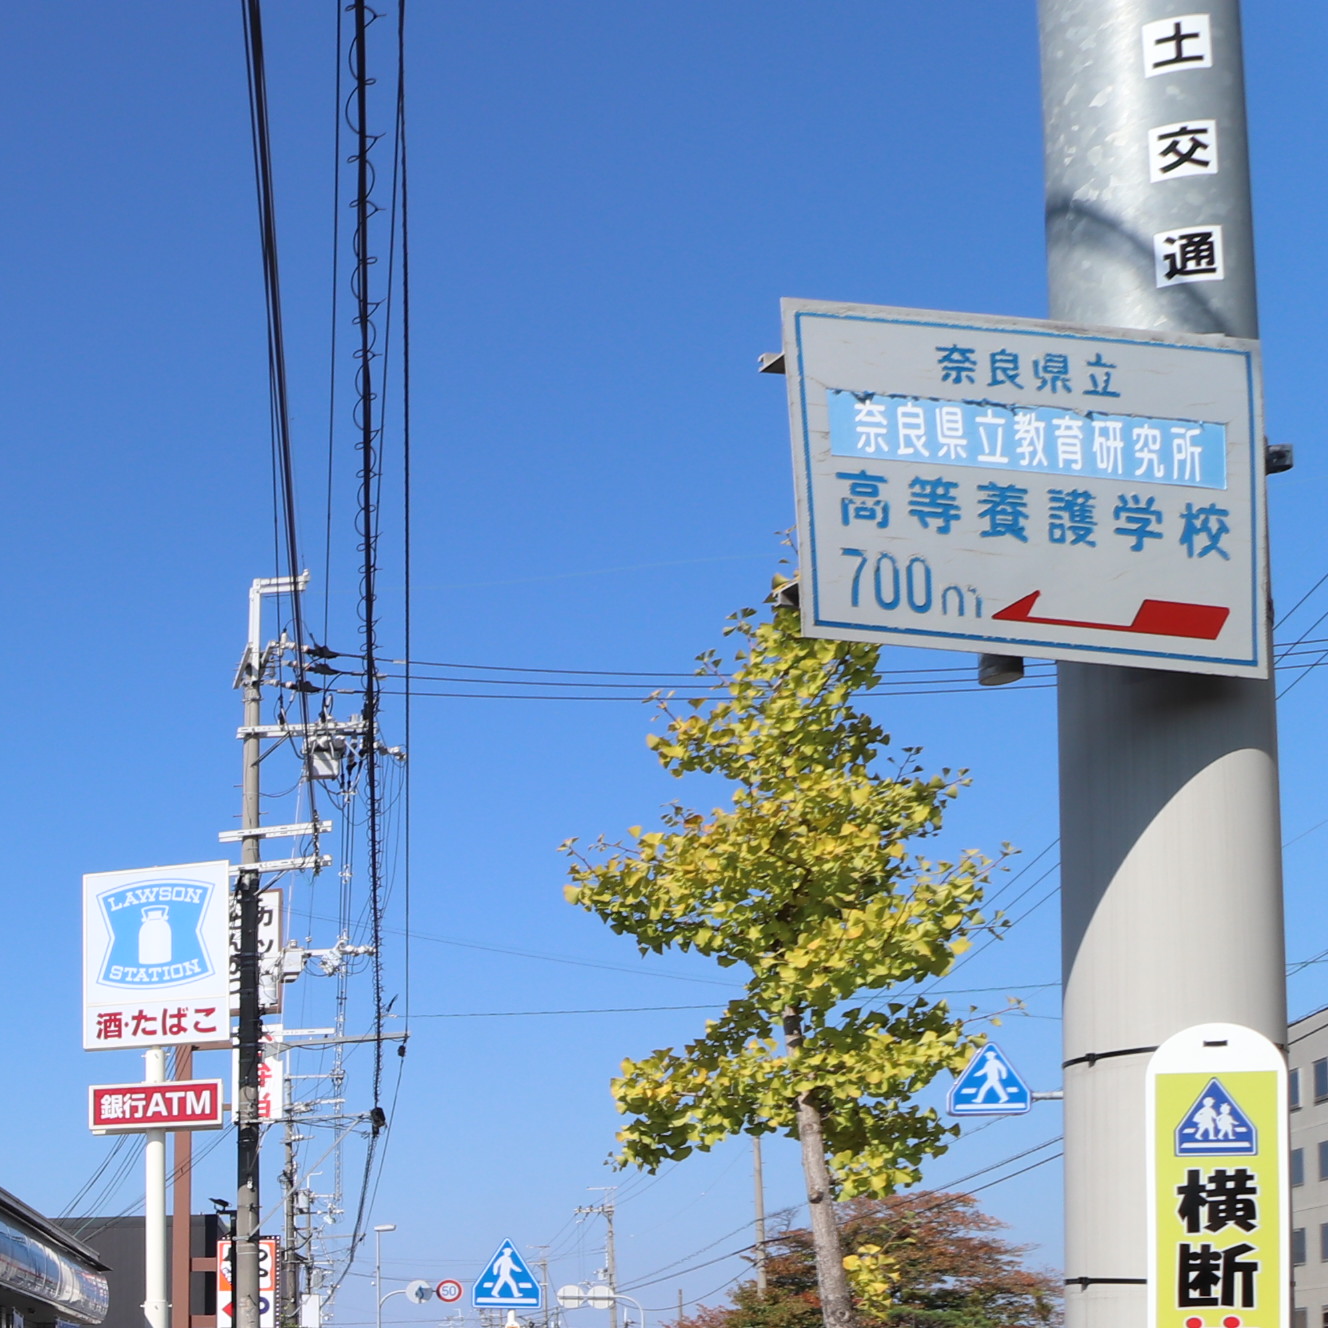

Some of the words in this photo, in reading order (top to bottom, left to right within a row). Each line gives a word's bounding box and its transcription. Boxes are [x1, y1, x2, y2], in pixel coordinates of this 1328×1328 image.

[935, 344, 1121, 398] 奈良県立
[853, 400, 1205, 483] 奈良県立教育研究所
[835, 469, 1231, 561] 高等養護学校
[107, 887, 203, 912] LAWSON
[109, 958, 202, 982] STATION
[100, 1089, 212, 1119] 銀行ATM
[441, 1285, 457, 1297] 50
